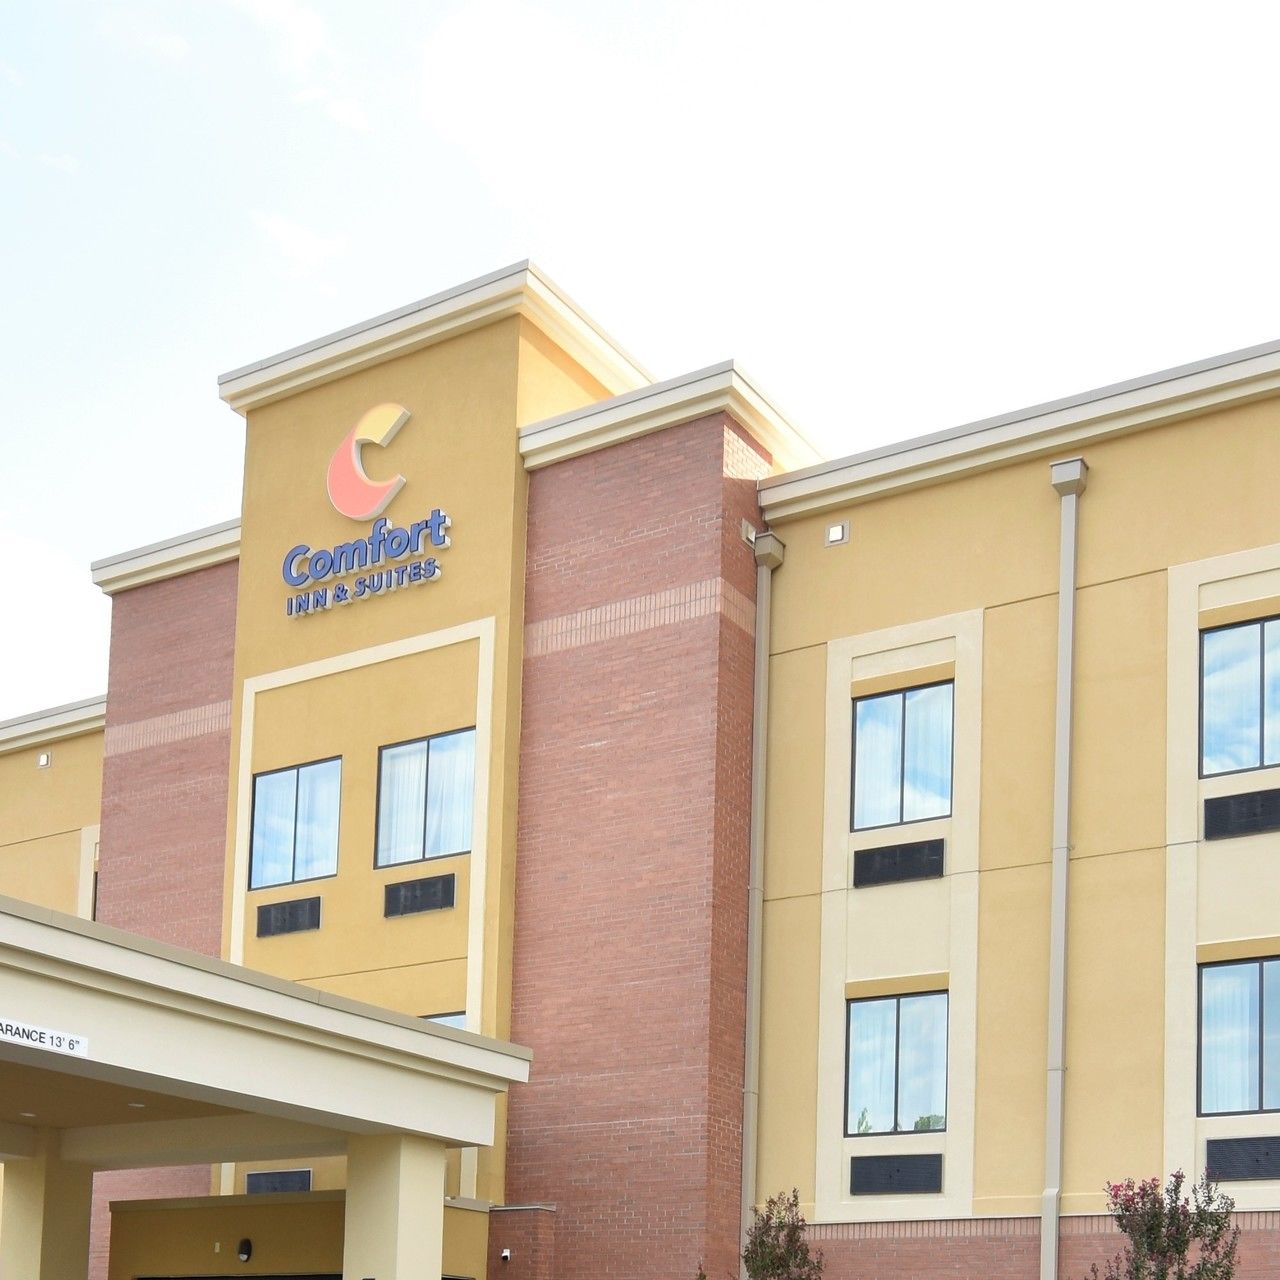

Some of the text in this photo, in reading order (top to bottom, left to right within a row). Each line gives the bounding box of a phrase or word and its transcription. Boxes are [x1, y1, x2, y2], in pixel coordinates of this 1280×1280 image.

[282, 508, 449, 588] Comfort
[286, 557, 439, 616] INN & SUITES
[49, 1035, 65, 1048] 13'
